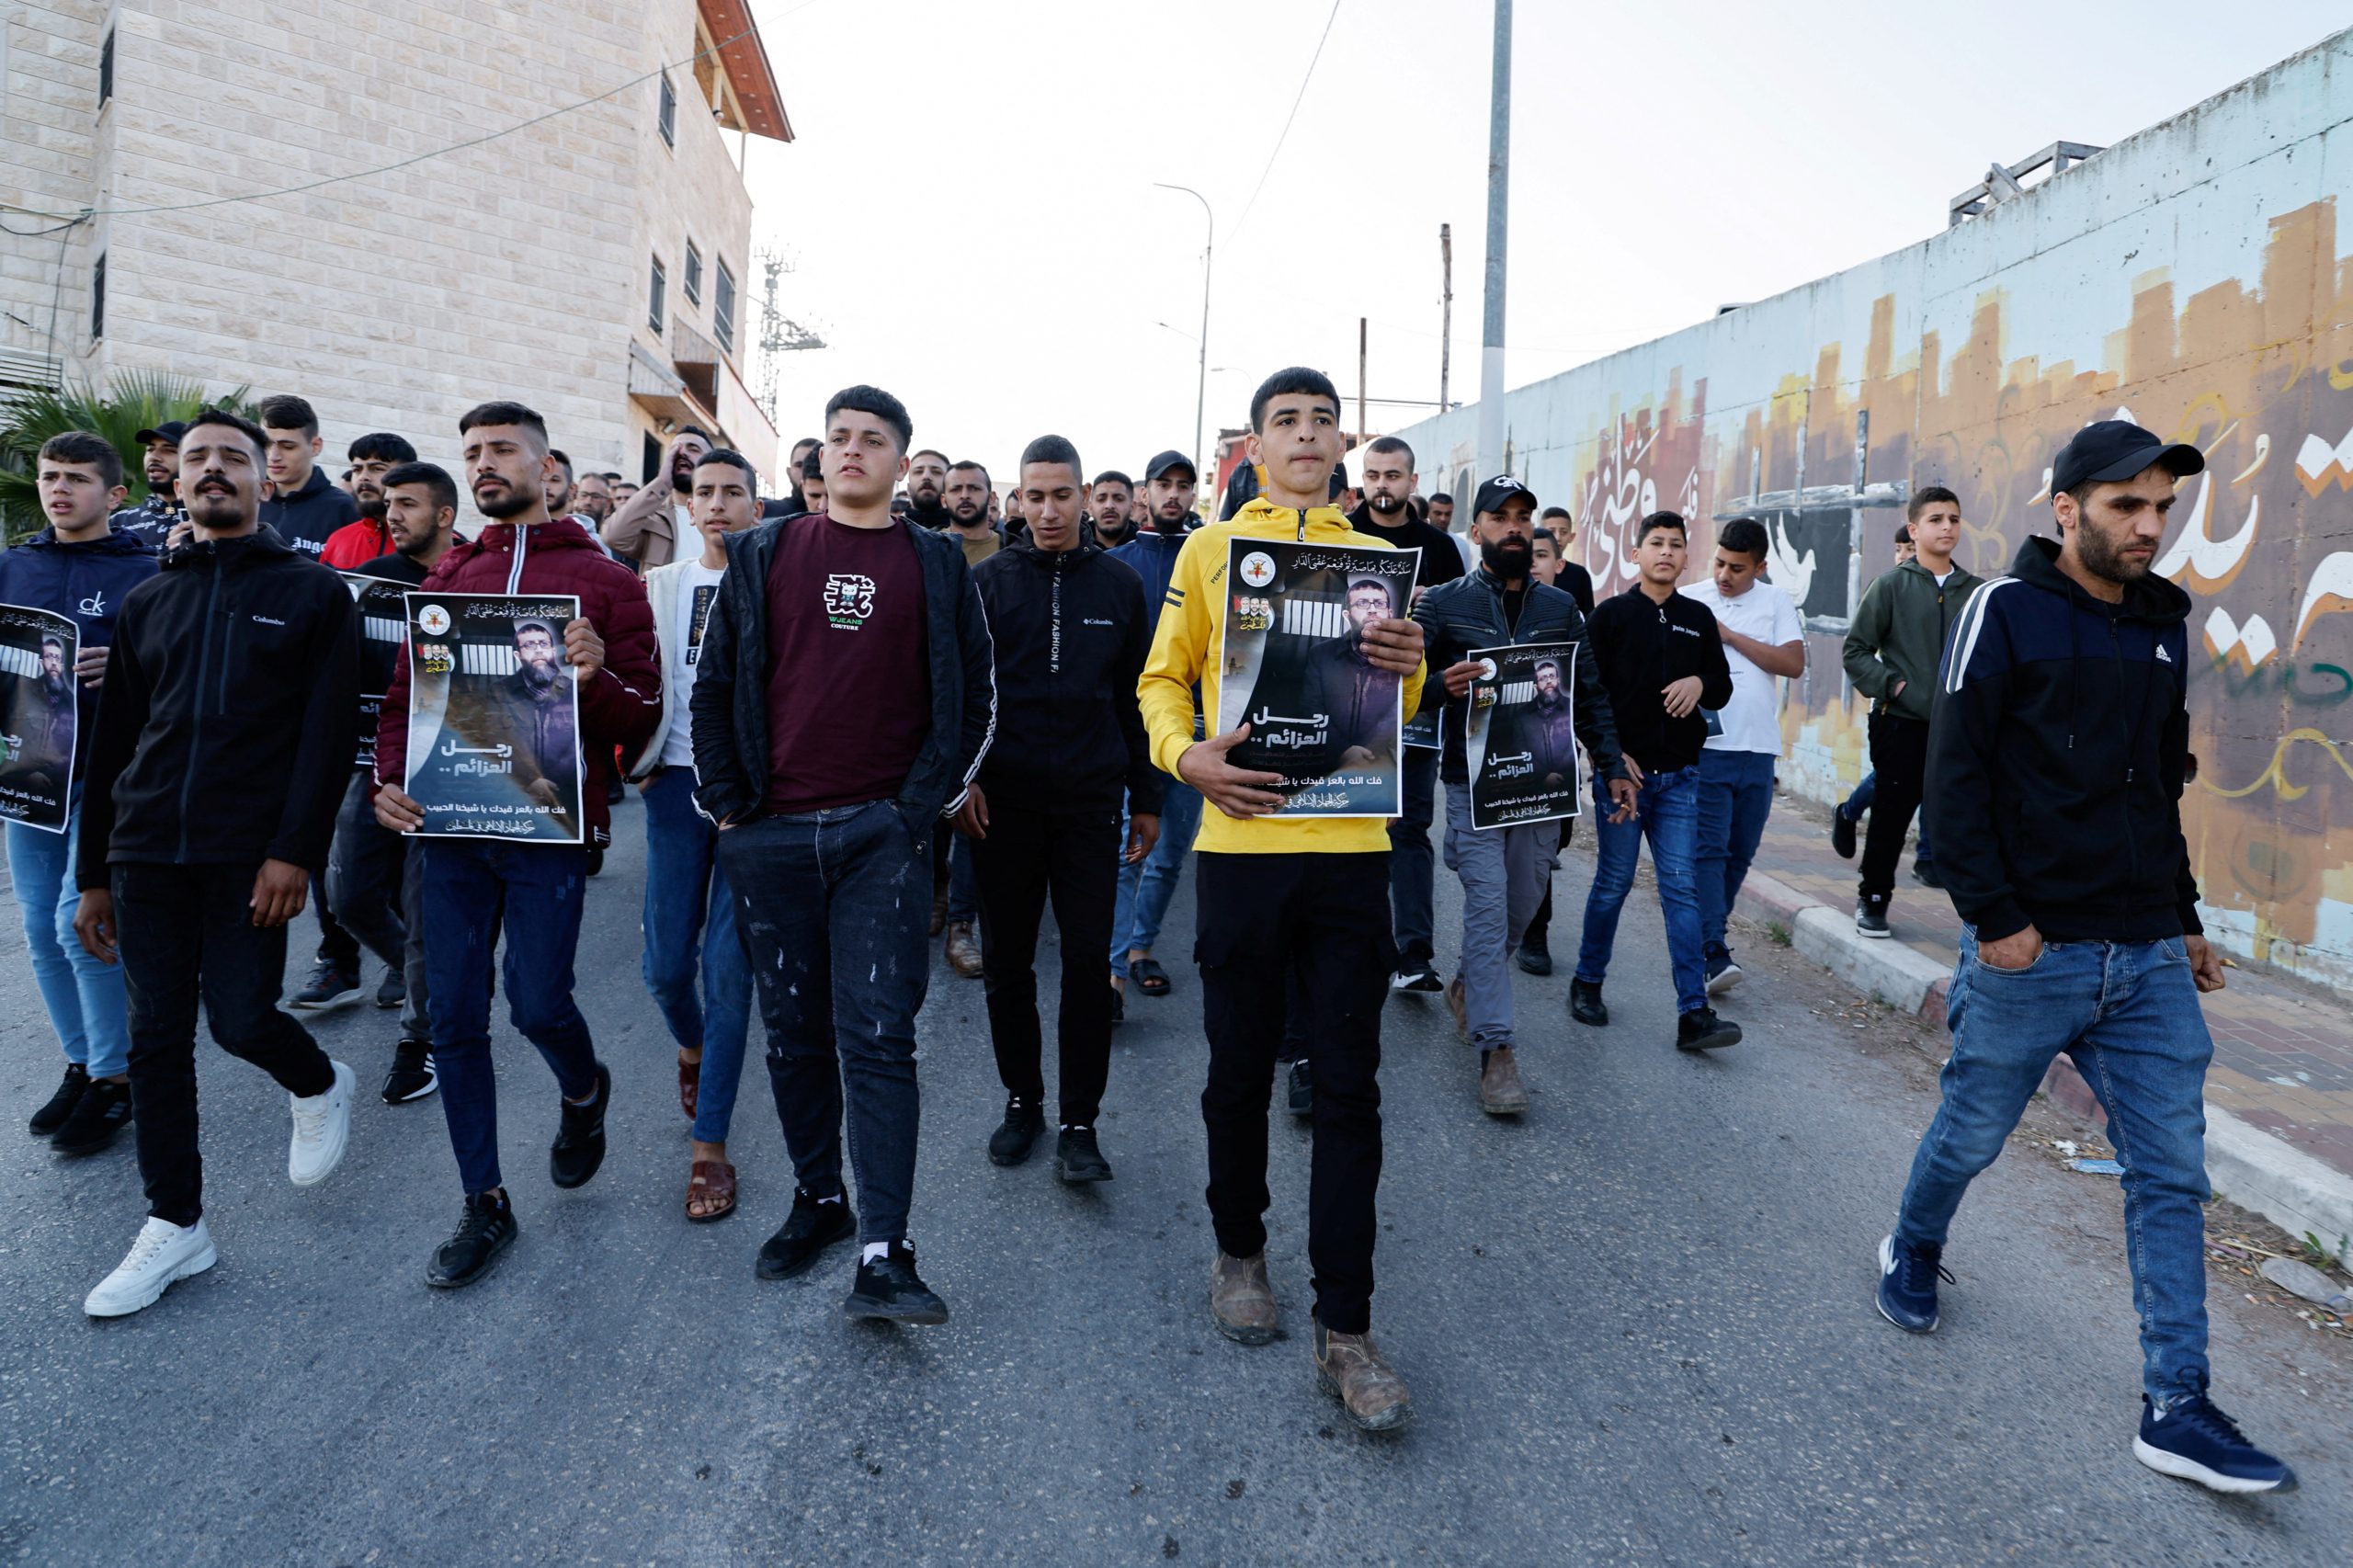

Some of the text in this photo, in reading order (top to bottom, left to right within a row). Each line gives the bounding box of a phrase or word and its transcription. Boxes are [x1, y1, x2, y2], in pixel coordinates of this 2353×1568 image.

[1210, 561, 1228, 585] PERFOR
[829, 616, 863, 625] WJEANS
[1051, 619, 1061, 662] FASHION
[1253, 706, 1329, 728] رجل
[441, 739, 512, 758] رجل
[1266, 729, 1327, 750] العزائم
[454, 758, 512, 777] العزائم
[1488, 751, 1532, 766] رجل
[1348, 776, 1364, 785] الله
[534, 805, 550, 813] الله
